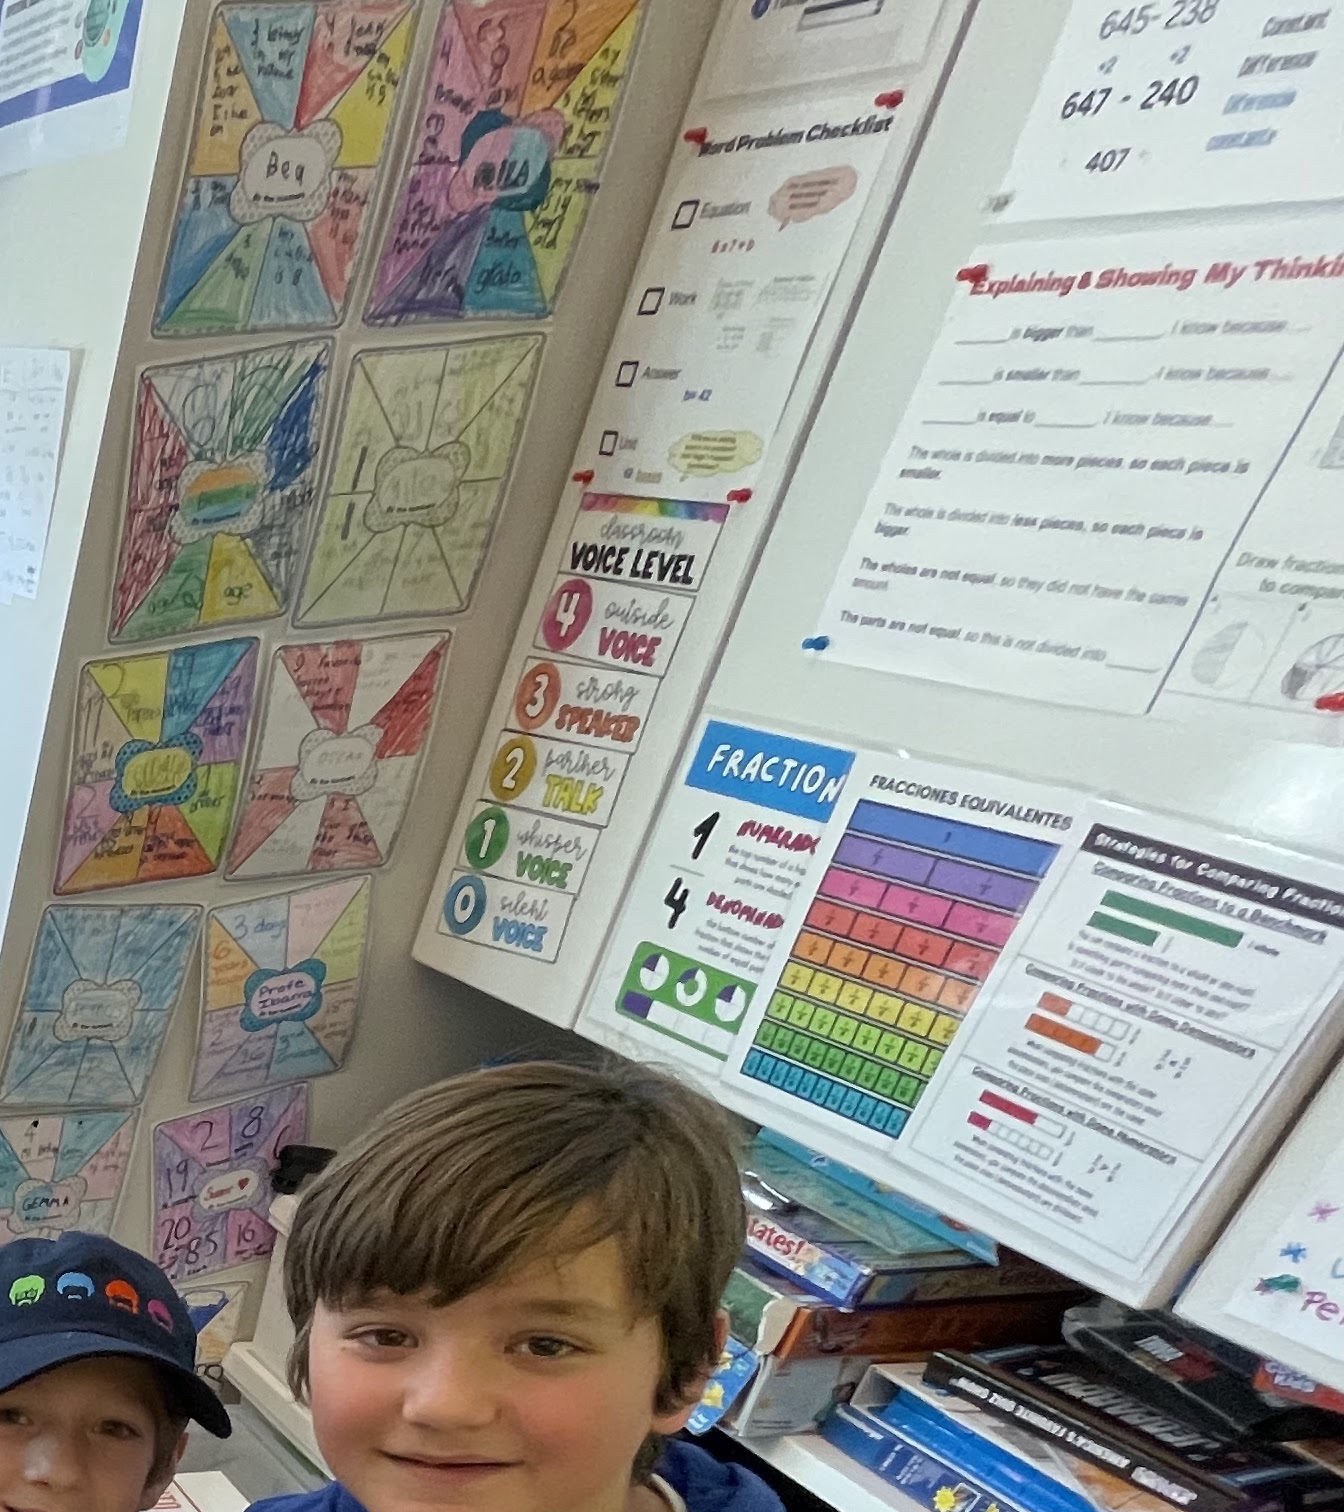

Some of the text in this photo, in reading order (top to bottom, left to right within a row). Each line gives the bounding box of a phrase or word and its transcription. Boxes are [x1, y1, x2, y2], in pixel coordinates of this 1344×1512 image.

[1061, 75, 1200, 119] 647 240
[736, 128, 806, 152] Problem
[804, 114, 894, 143] Checklist
[1085, 147, 1131, 173] 407
[969, 270, 1076, 299] Explaining
[1094, 262, 1198, 291] Showing
[1204, 262, 1247, 289] My
[570, 541, 696, 586] VOICE LEVEL
[556, 592, 582, 639] 4
[597, 626, 662, 668] VOICE
[524, 673, 549, 718] 3
[554, 704, 642, 743] SPEAKER
[502, 747, 524, 790] 2
[707, 744, 847, 804] FRACTION
[542, 773, 605, 816] TALK
[869, 774, 1074, 832] FRACCIONES EQUIVALENTES
[478, 818, 496, 859] 1
[693, 811, 720, 861] 1
[516, 850, 574, 890] VOICE
[1094, 832, 1169, 864] Strategies
[1170, 854, 1194, 871] for
[1196, 862, 1281, 899] Comparing
[453, 884, 476, 924] 0
[664, 877, 690, 930] 4
[492, 915, 549, 953] VOICE
[191, 1120, 219, 1151] 2
[241, 1105, 265, 1139] 8
[166, 1158, 190, 1199] 19
[22, 1196, 70, 1212] GEMMA
[160, 1215, 192, 1251] 20
[184, 1230, 219, 1265] 85
[236, 1219, 256, 1247] 16
